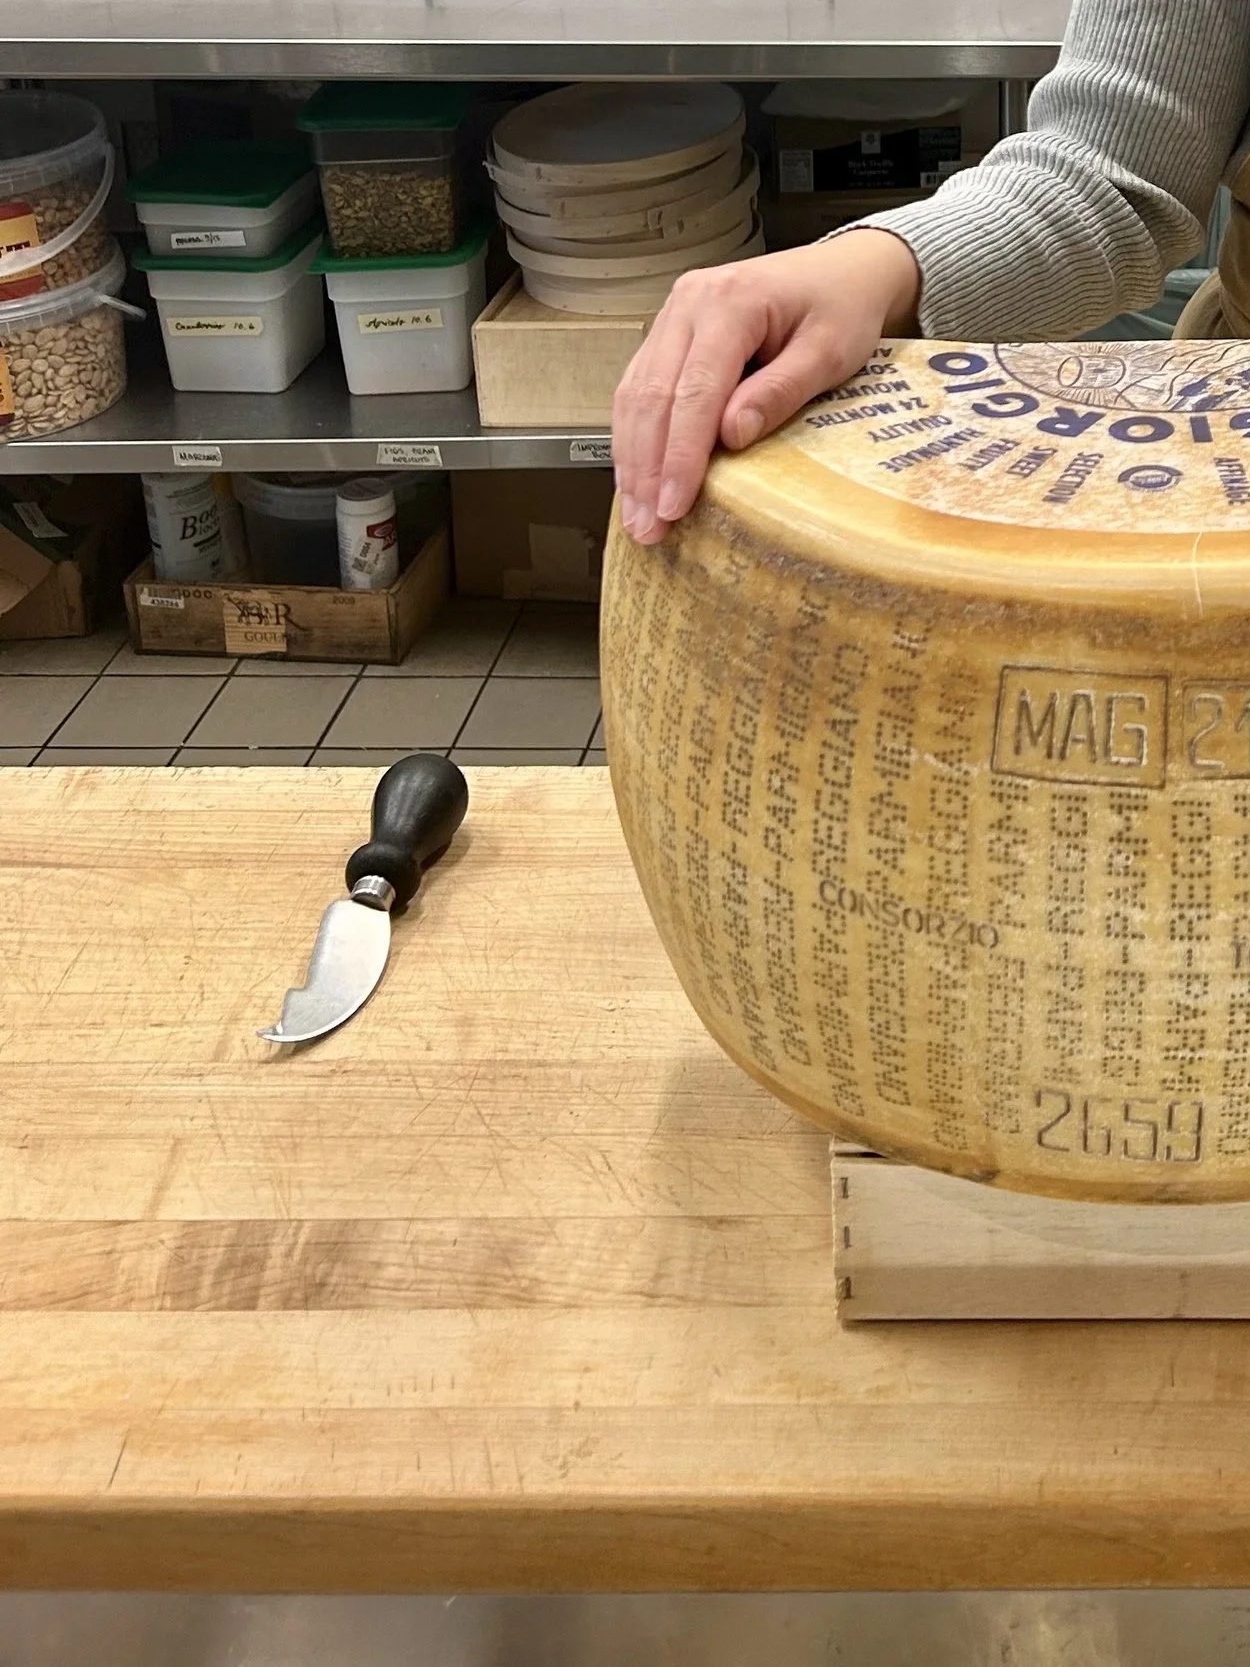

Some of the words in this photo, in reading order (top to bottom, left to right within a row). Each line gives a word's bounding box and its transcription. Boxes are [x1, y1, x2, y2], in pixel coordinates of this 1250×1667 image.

[805, 404, 896, 429] MONTHS
[872, 414, 952, 443] QUALITY
[878, 427, 985, 473] HANDMADE
[958, 438, 1021, 471] FRUITY
[1007, 445, 1059, 478] SWEET
[1043, 451, 1104, 505] SELECTION
[1013, 688, 1148, 767] MAG
[812, 643, 870, 882] REGGIANO
[819, 879, 1001, 951] CONSORZIO
